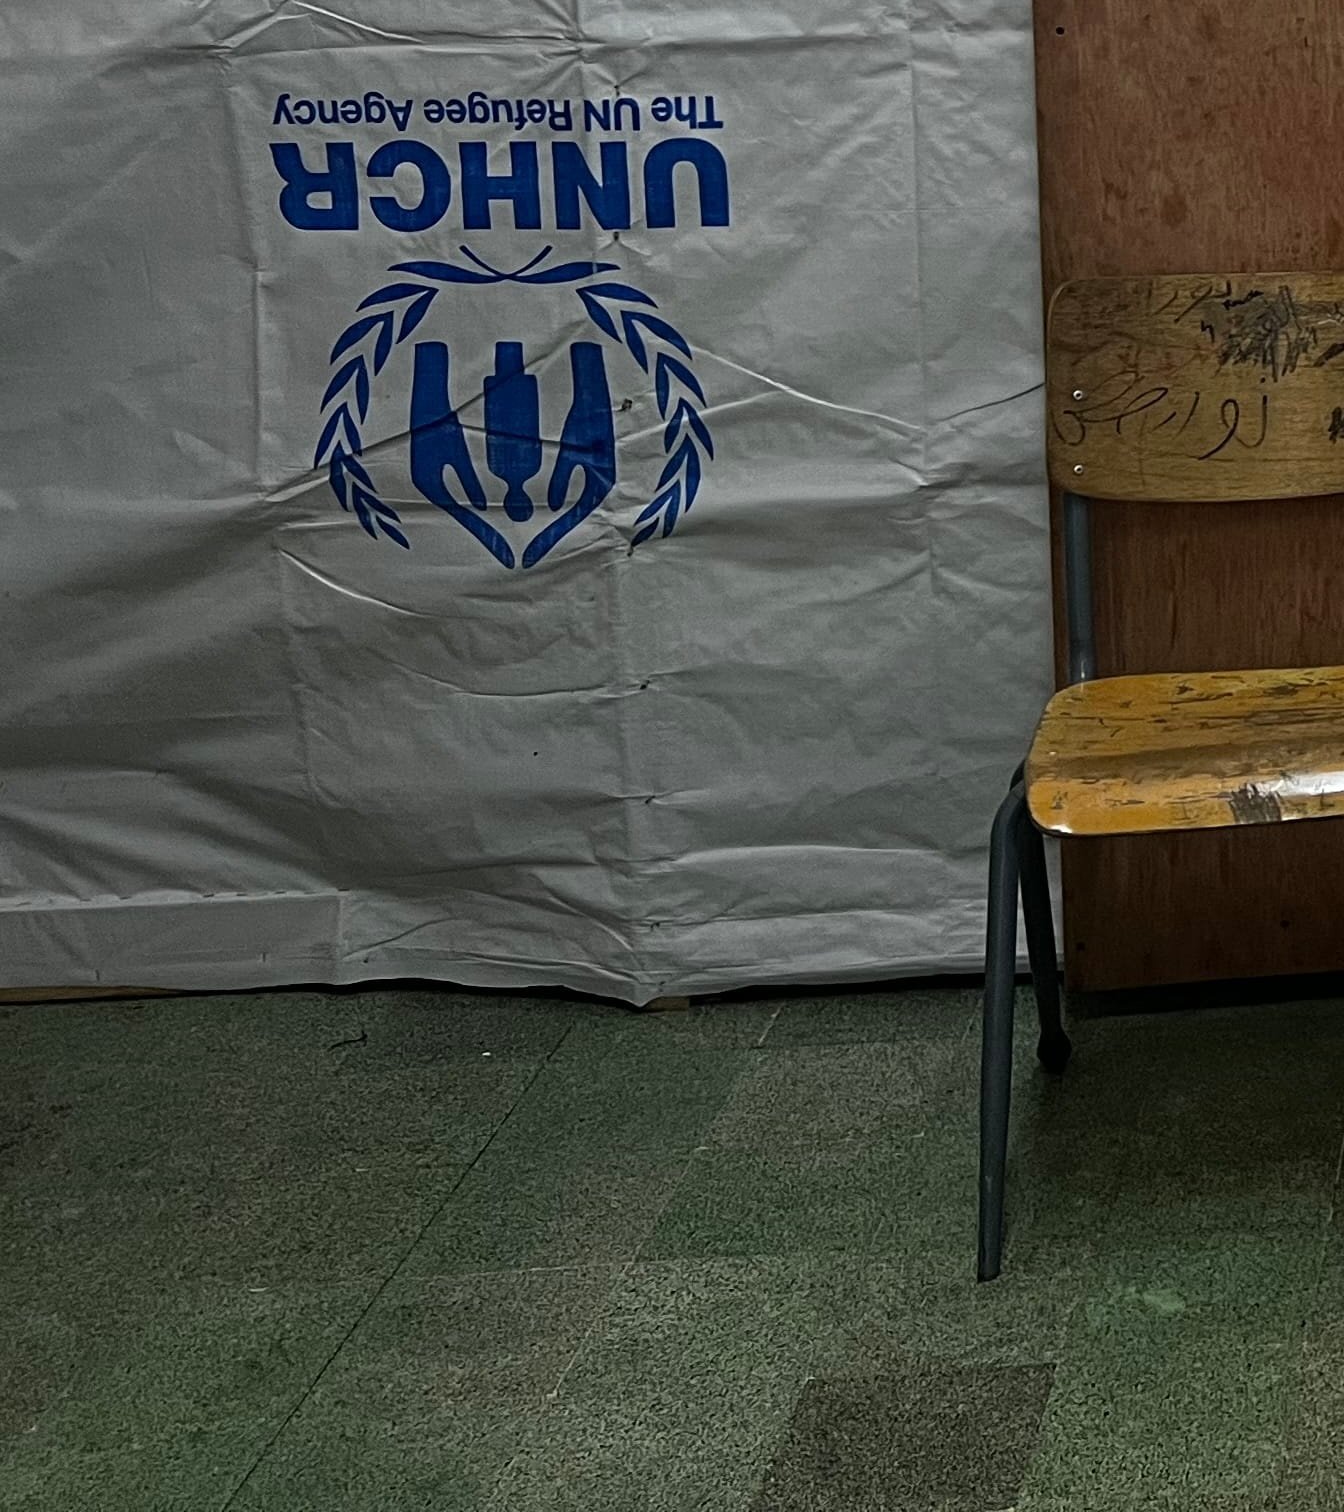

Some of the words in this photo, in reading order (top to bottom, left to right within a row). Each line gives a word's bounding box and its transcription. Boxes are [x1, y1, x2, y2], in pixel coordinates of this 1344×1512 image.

[272, 92, 413, 131] Agency
[423, 94, 573, 131] Refugee
[583, 97, 641, 131] UN
[650, 95, 724, 130] The
[269, 137, 732, 232] UNHCR
